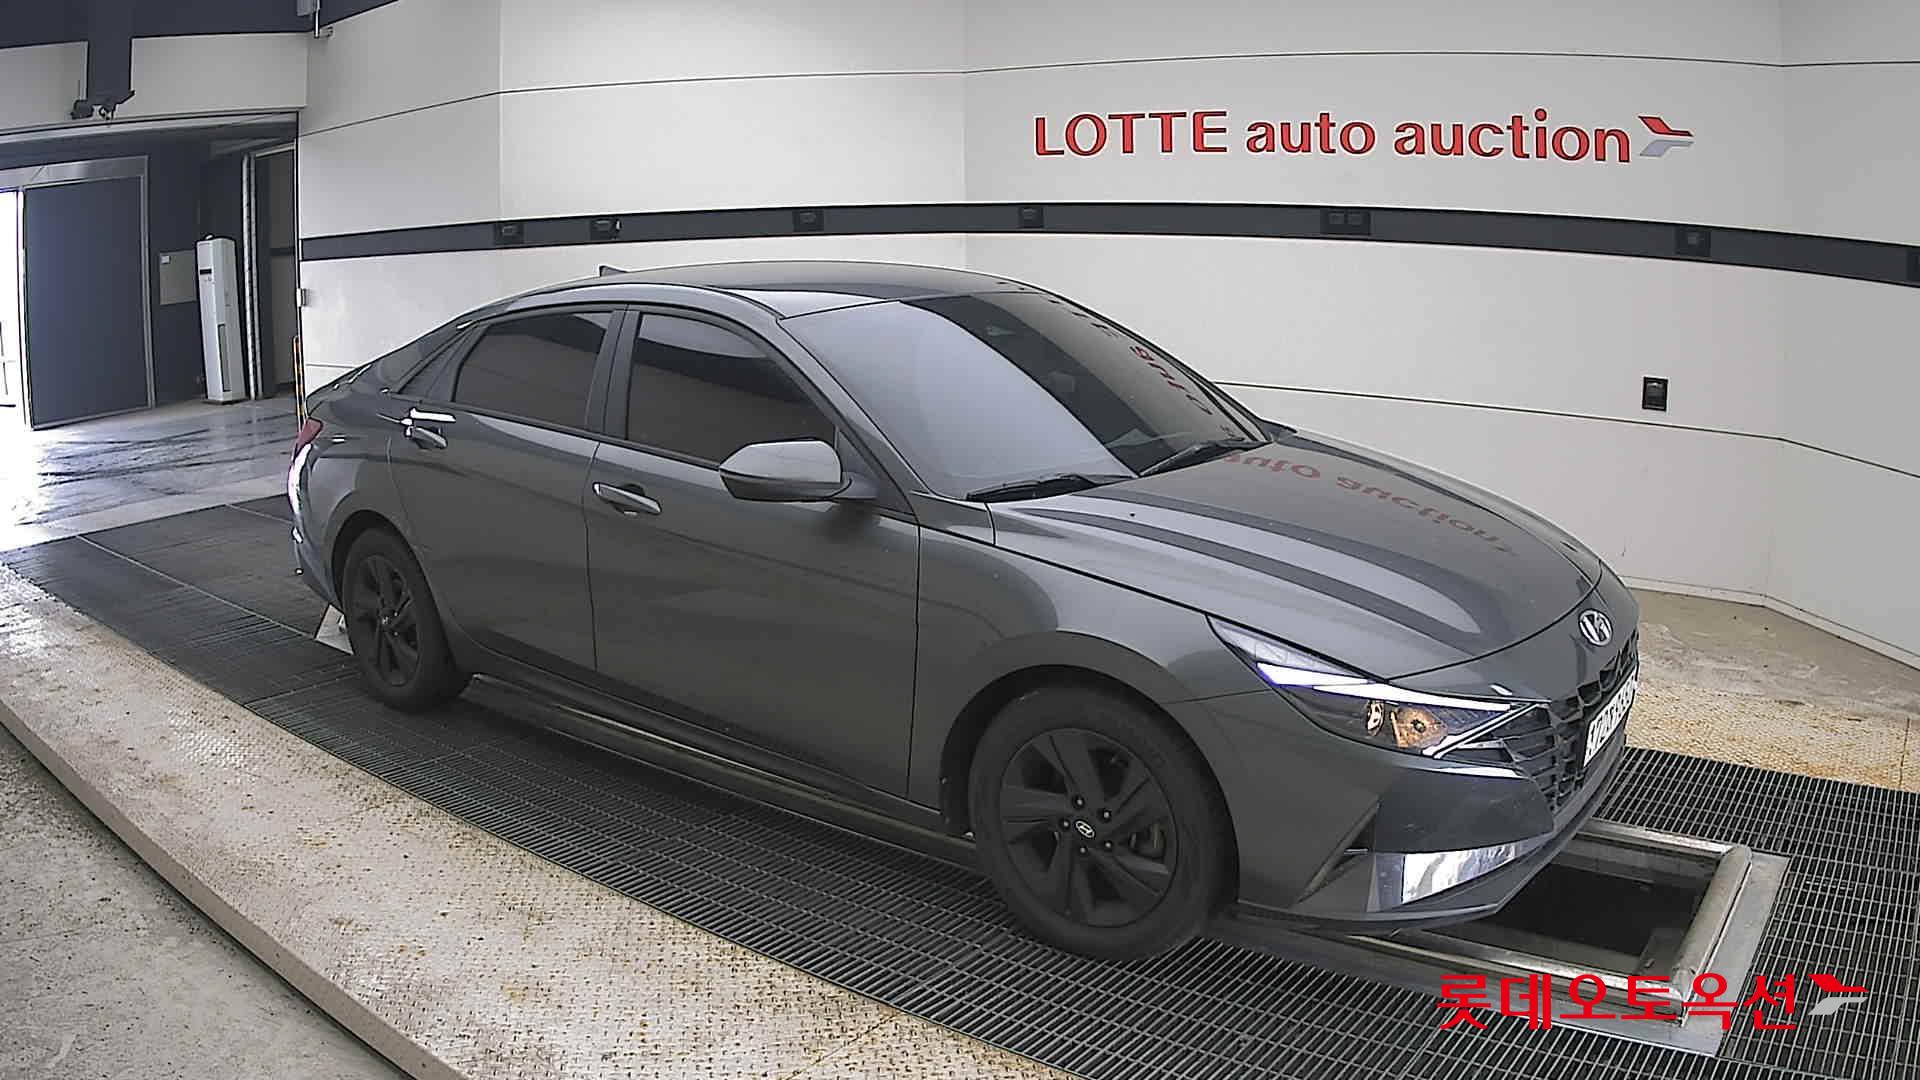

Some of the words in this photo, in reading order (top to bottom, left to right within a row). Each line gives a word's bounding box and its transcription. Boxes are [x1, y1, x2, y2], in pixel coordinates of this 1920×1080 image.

[1034, 111, 1228, 157] LOTTE
[1246, 112, 1376, 155] auto
[1393, 109, 1631, 163] auction
